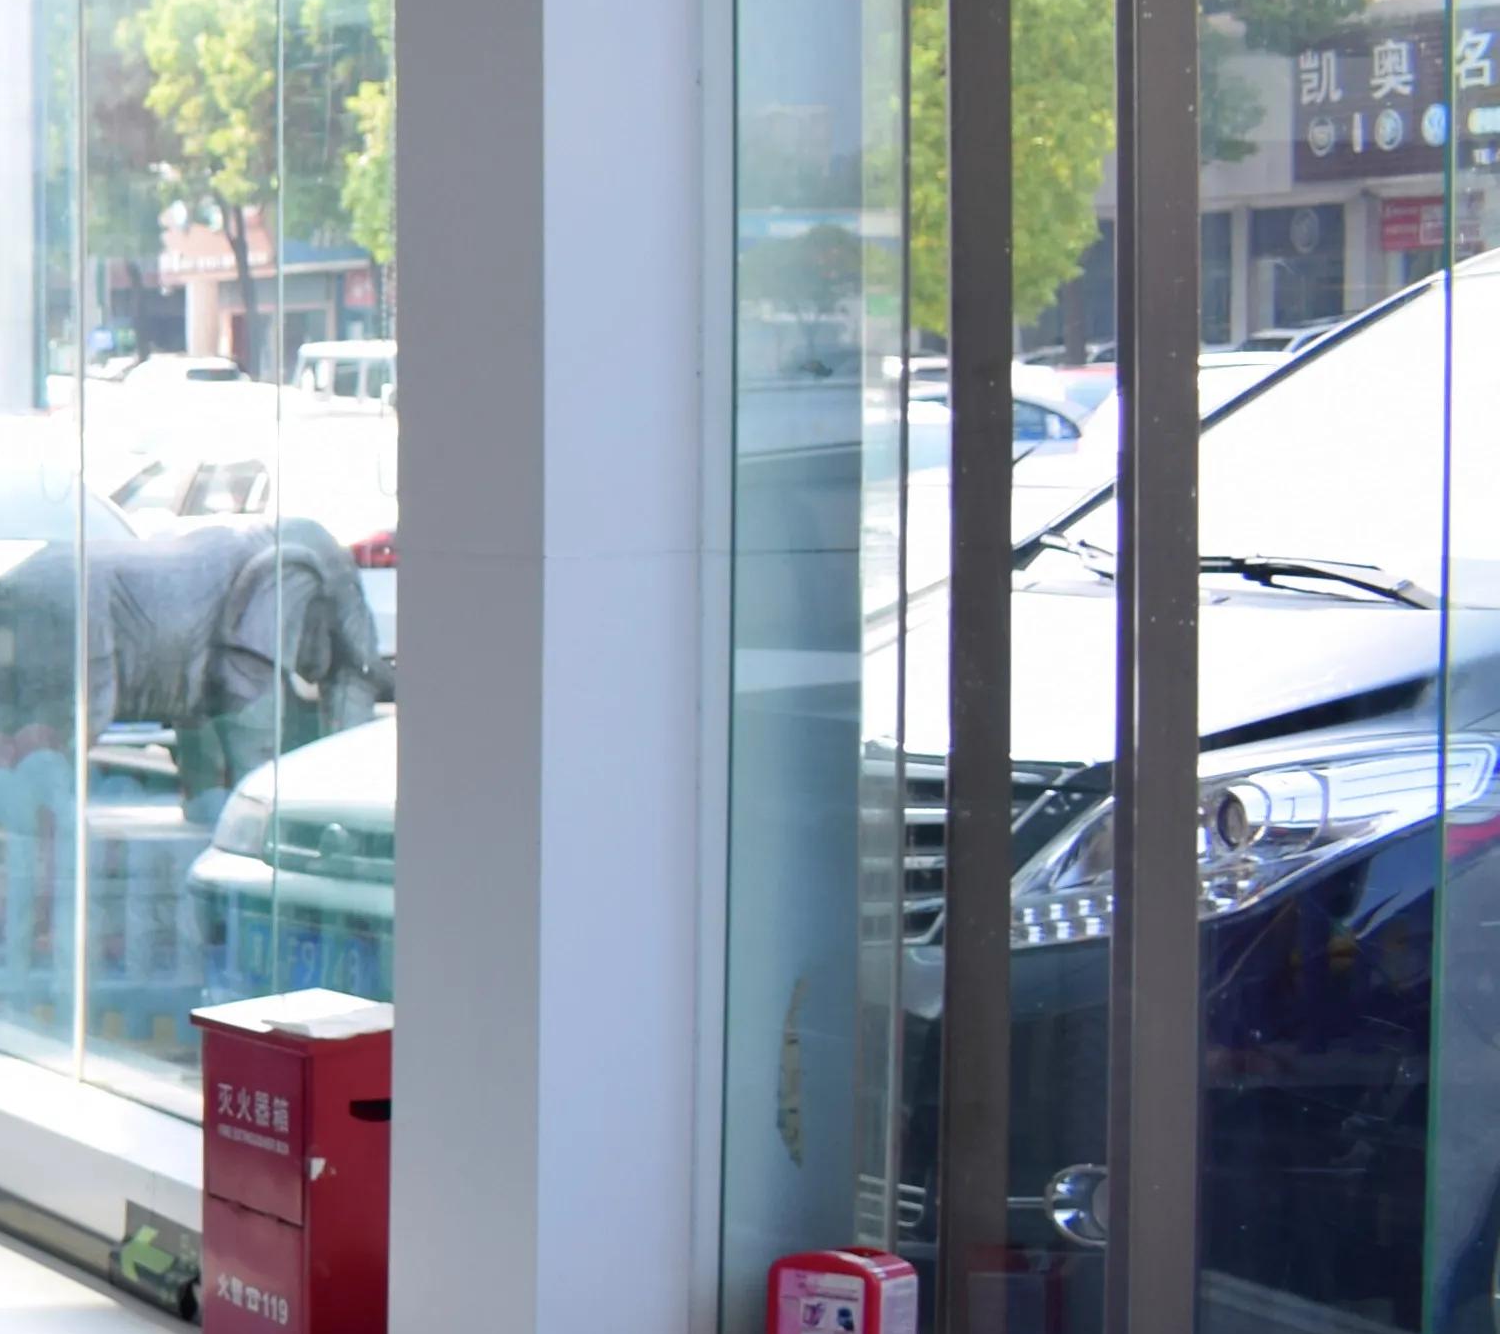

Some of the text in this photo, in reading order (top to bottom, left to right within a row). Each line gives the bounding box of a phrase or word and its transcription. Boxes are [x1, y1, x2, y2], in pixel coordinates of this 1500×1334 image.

[217, 1083, 290, 1135] 灭火器箱
[263, 1289, 289, 1327] 119
